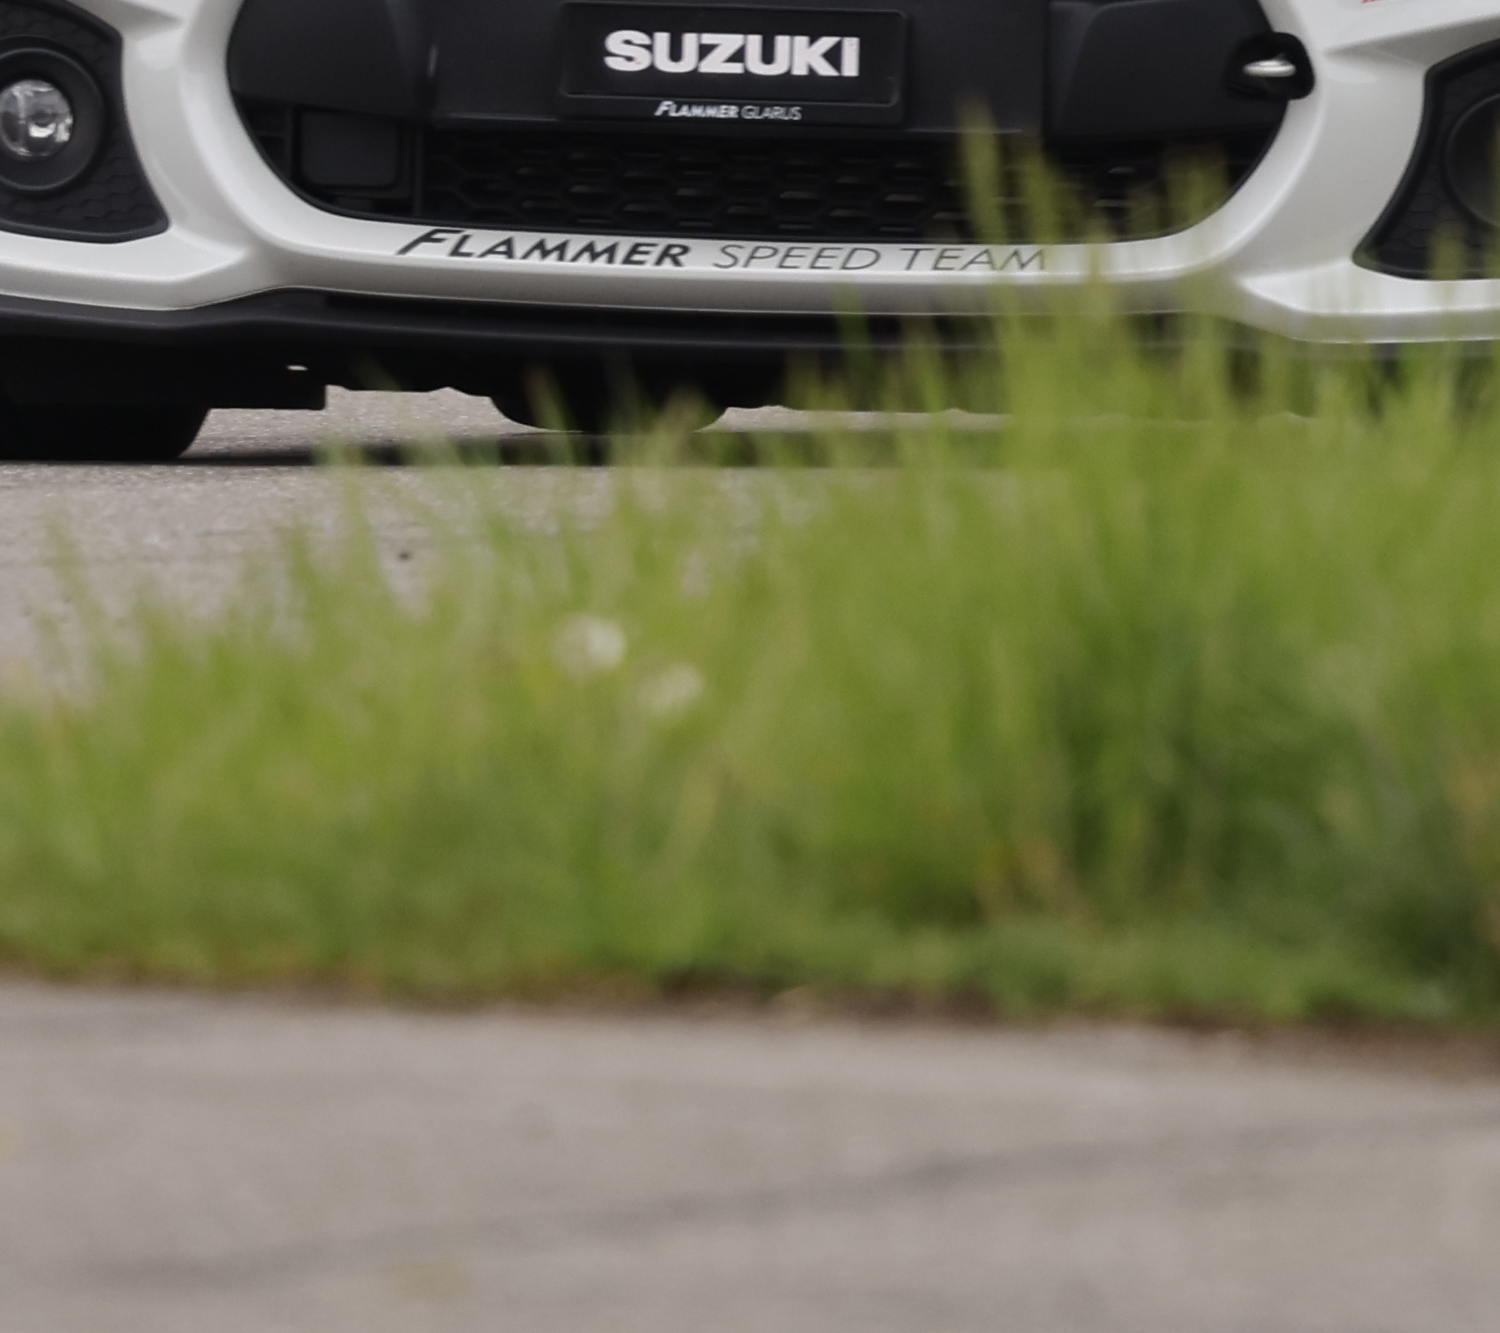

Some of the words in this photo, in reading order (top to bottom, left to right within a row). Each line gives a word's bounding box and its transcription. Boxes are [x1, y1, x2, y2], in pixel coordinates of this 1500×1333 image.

[603, 30, 860, 78] SUZUKI
[654, 101, 739, 119] FLAMMER
[740, 105, 803, 121] GLARUS
[397, 228, 691, 269] FLAMMER
[712, 243, 882, 272] SPEED
[900, 246, 1048, 273] TEAM
